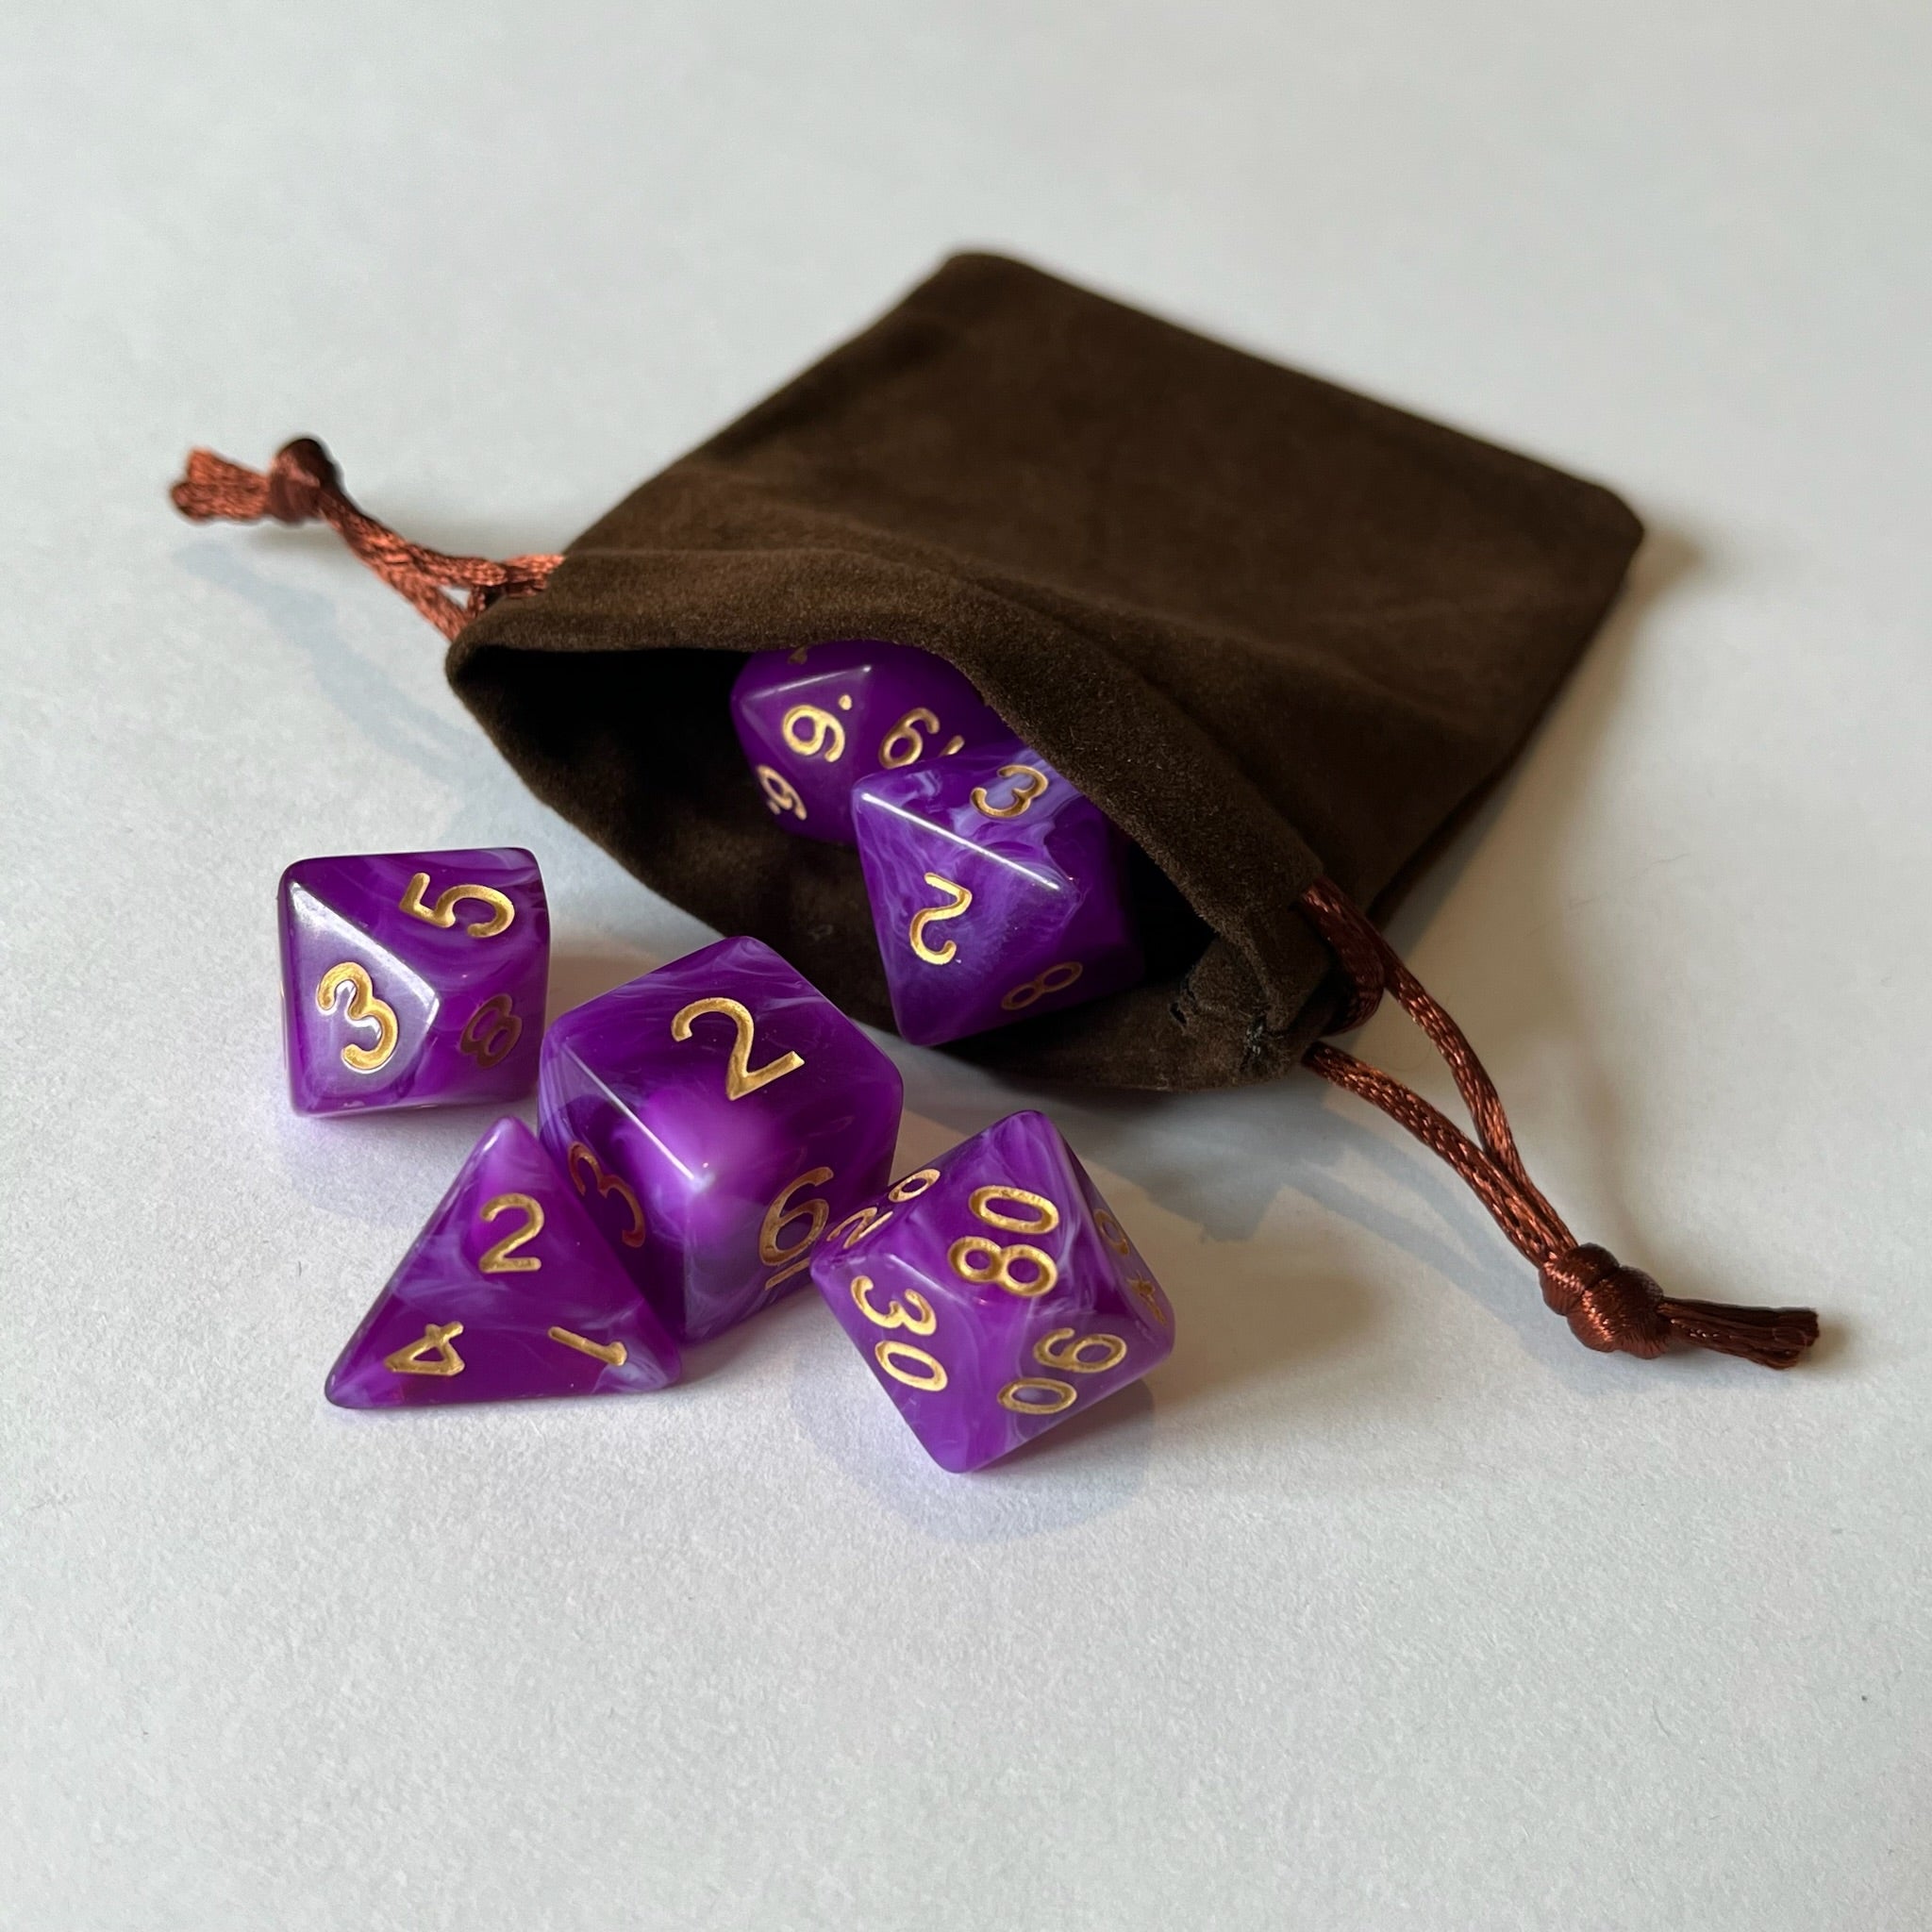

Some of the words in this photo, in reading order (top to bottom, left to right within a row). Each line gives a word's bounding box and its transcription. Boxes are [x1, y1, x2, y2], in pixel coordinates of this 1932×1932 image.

[971, 764, 1048, 819] 3
[398, 872, 515, 938] 5
[909, 873, 972, 965] 2
[316, 961, 399, 1074] 3
[1001, 961, 1083, 1010] 8
[459, 993, 523, 1068] 8
[671, 997, 806, 1101] 2
[478, 1192, 544, 1274] 2
[569, 1141, 645, 1248] 3
[826, 1169, 941, 1249] 20
[948, 1185, 1060, 1297] 80
[384, 1321, 465, 1376] 4
[548, 1326, 627, 1366] 1
[851, 1275, 948, 1391] 30
